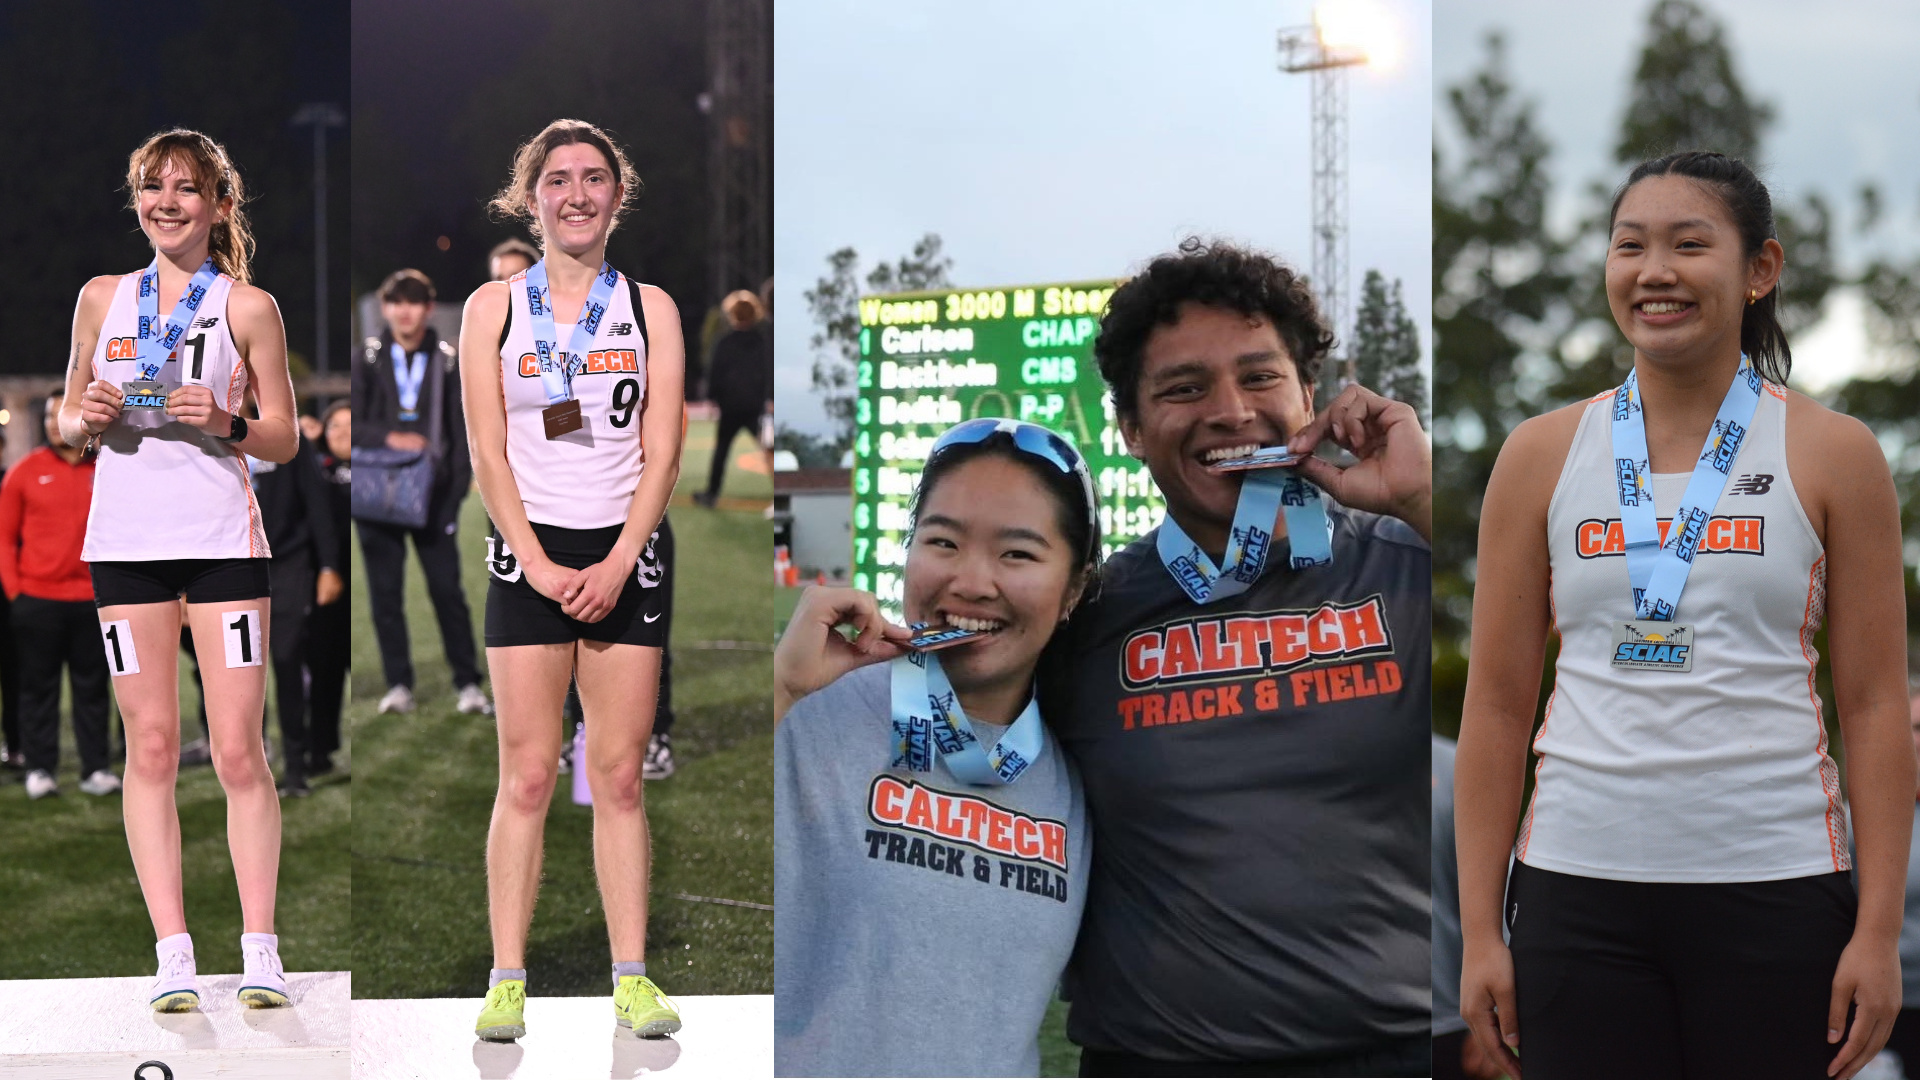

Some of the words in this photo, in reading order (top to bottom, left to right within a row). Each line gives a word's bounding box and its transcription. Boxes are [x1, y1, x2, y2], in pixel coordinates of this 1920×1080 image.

[186, 285, 207, 311] SCIAC
[527, 286, 543, 316] SCIAC
[859, 298, 938, 325] Women
[946, 291, 1006, 321] 3000
[1014, 289, 1035, 317] M
[138, 316, 149, 339] SCIAC
[585, 303, 605, 336] SCIAC
[859, 328, 871, 355] 1
[881, 324, 974, 354] Carlson
[1022, 317, 1094, 348] CHAP
[164, 324, 184, 350] SCIAC
[185, 333, 206, 380] 1
[519, 349, 639, 378] CECH
[535, 340, 552, 372] SCIAC
[858, 361, 873, 388] 2
[1022, 356, 1077, 384] CMS
[123, 395, 166, 407] SCIAC
[609, 378, 639, 428] 9
[856, 397, 872, 425] 3
[1020, 393, 1065, 420] P-P
[856, 430, 870, 458] 4
[1713, 420, 1744, 475] SCIAC
[856, 467, 870, 495] 5
[1618, 458, 1639, 507] SCIAC
[855, 502, 870, 530] 6
[854, 537, 869, 564] 7
[1576, 516, 1764, 560] CACH
[1676, 507, 1707, 563] SCIAC
[1235, 525, 1271, 583] SCIAC
[1169, 556, 1211, 600] SCIAC
[105, 624, 124, 673] 1
[229, 614, 252, 663] 1
[1122, 596, 1391, 687] CALTECH
[1614, 642, 1690, 664] SCIAC
[1118, 685, 1243, 730] TRACK
[1254, 679, 1279, 711] &
[1290, 661, 1402, 706] FIELD
[999, 750, 1027, 782] CIAC
[870, 776, 1067, 870] CALTECH
[865, 829, 965, 877] TRACK
[973, 855, 991, 883] &
[1000, 861, 1068, 904] FIELD
